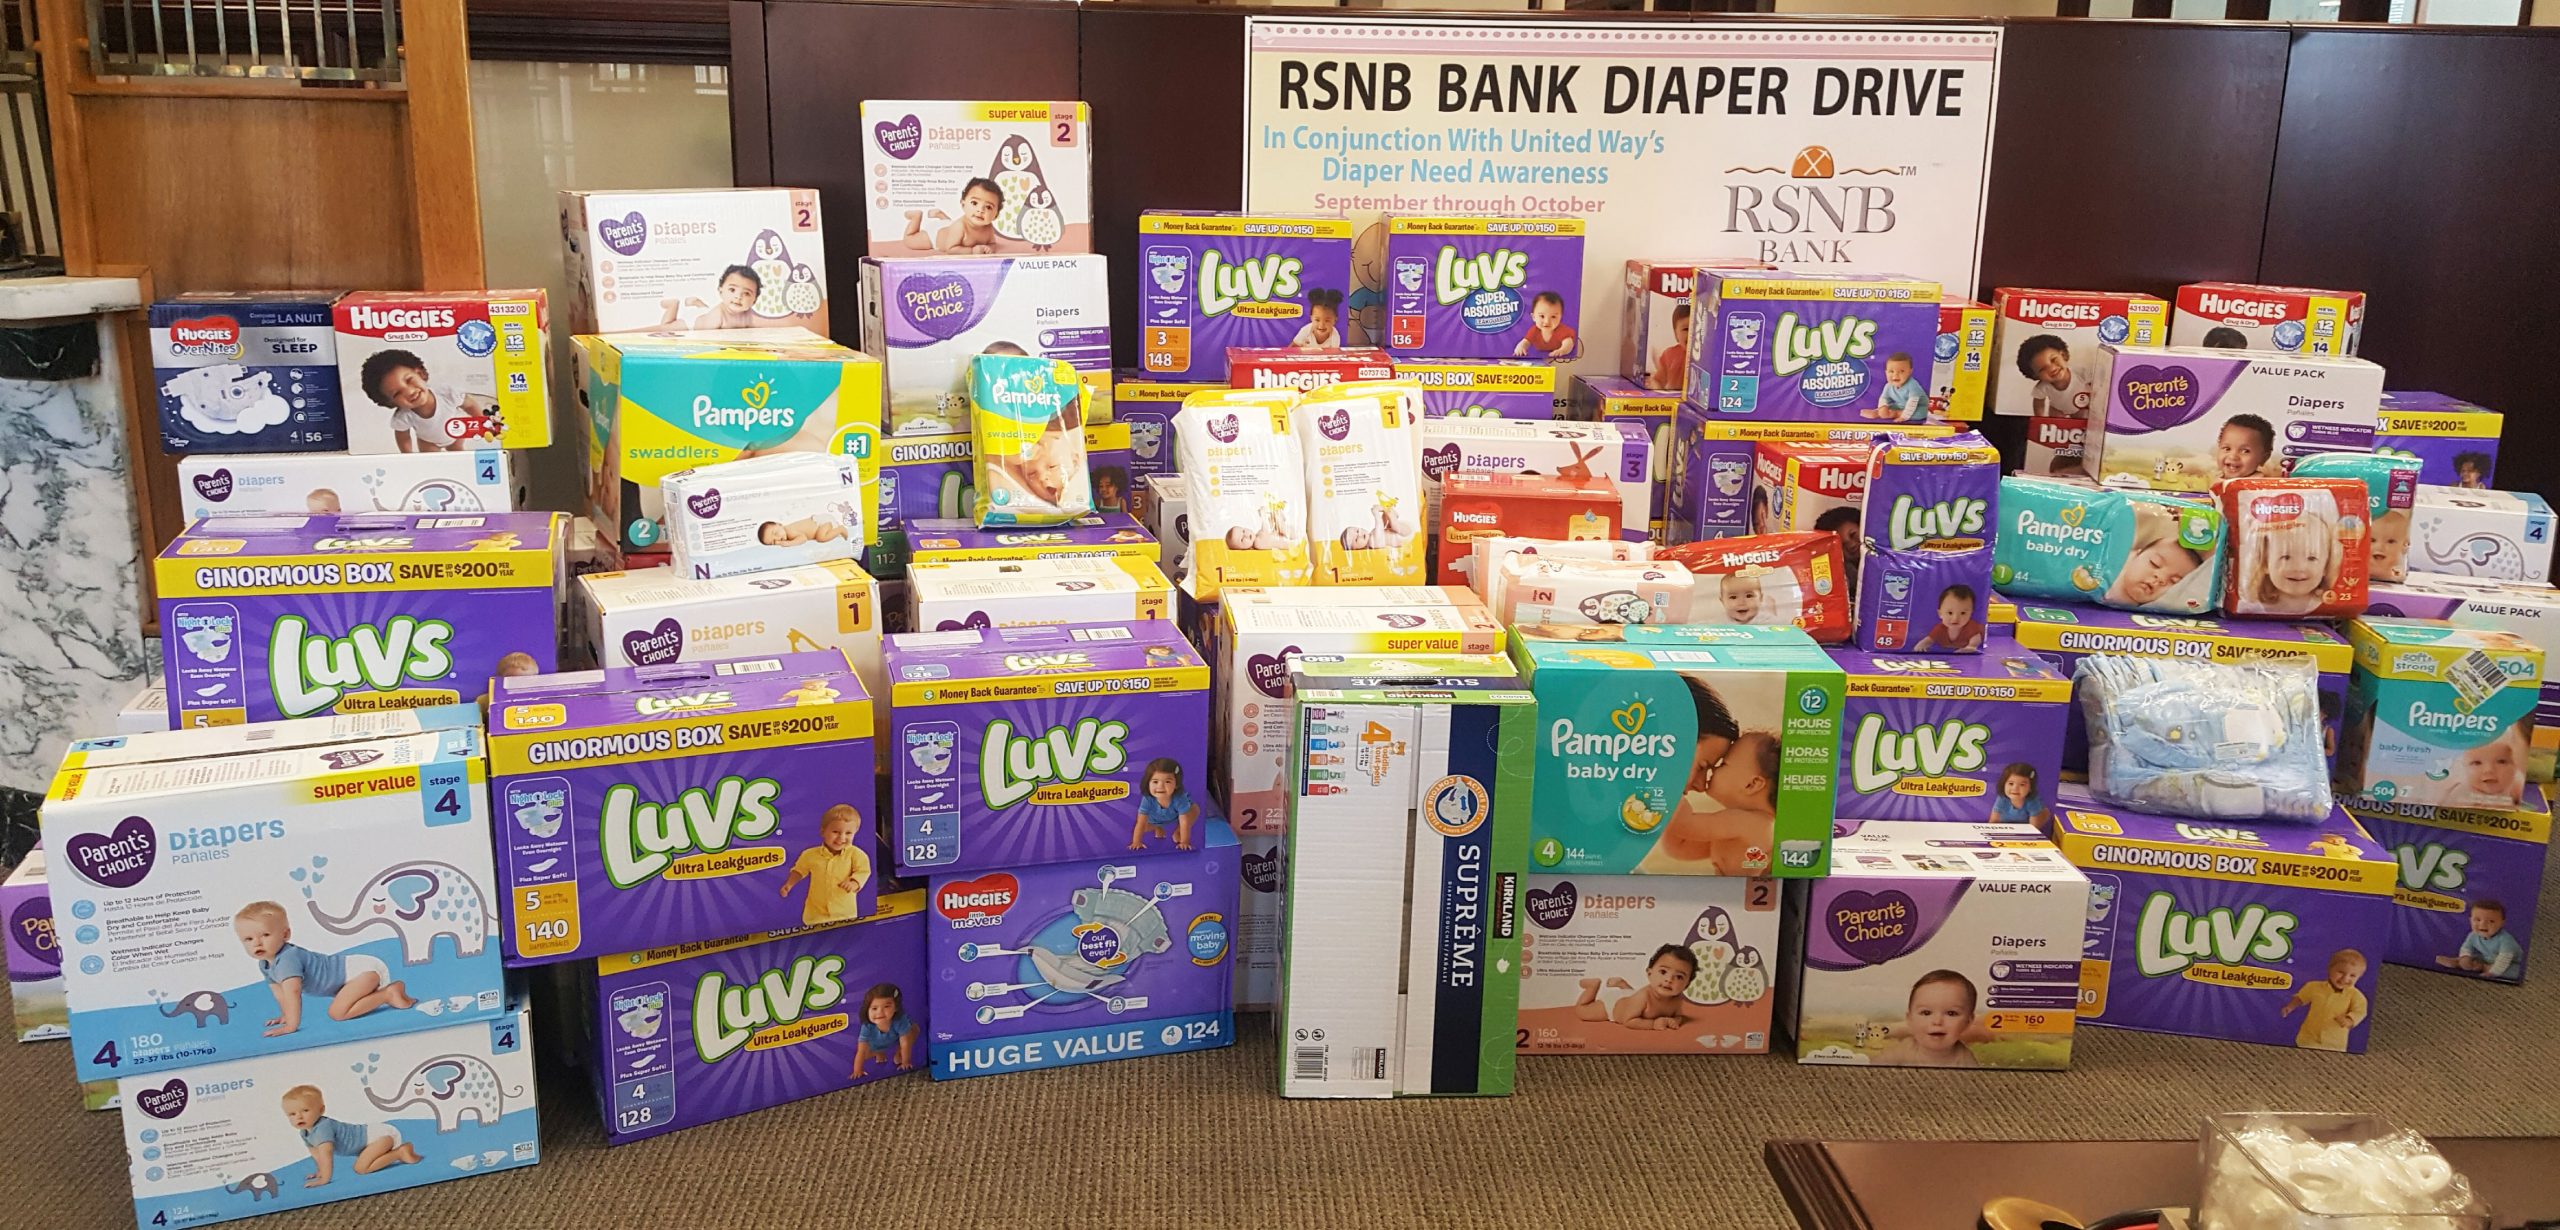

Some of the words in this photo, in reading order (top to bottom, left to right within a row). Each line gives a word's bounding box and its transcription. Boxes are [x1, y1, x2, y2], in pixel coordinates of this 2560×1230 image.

[1280, 61, 1411, 112] RSNB
[1438, 63, 1580, 113] BANK
[1604, 66, 1789, 115] DIAPER
[1812, 67, 1964, 116] DRIVE
[989, 110, 1017, 120] super
[1020, 110, 1047, 119] value
[928, 128, 990, 140] Diapers
[890, 139, 917, 151] CHOICE
[1264, 126, 1286, 148] In
[1293, 127, 1441, 156] Conjunction
[1448, 128, 1502, 152] With
[1511, 129, 1591, 152] United
[1598, 130, 1664, 159] Way's
[1323, 158, 1404, 187] Diaper
[1411, 160, 1472, 182] Need
[1479, 160, 1609, 184] Awareness
[1899, 166, 1916, 176] TM
[1315, 193, 1428, 215] September
[1433, 195, 1514, 214] through
[1522, 195, 1605, 212] October
[1721, 185, 1896, 233] RSNB
[615, 237, 641, 249] CHOICE
[1759, 240, 1852, 262] BANK
[1019, 261, 1049, 269] VALUE
[1052, 260, 1077, 269] PACK
[1475, 291, 1506, 304] SUPER
[1745, 286, 1766, 297] Money
[1768, 287, 1783, 296] Back
[1784, 287, 1820, 297] Guarantee
[1036, 307, 1079, 318] Diapers
[1257, 307, 1298, 315] Leakguards
[1464, 302, 1520, 317] ABSORBENT
[2199, 293, 2286, 319] HUGGIES
[278, 314, 293, 323] LA
[295, 314, 323, 323] NUIT
[351, 307, 454, 331] HUGGIES
[1393, 335, 1412, 345] 136
[272, 344, 317, 353] SLEEP
[1149, 354, 1172, 366] 148
[1816, 362, 1849, 375] SUPER
[2252, 366, 2290, 378] VALUE
[2294, 368, 2325, 379] PACK
[510, 374, 526, 383] 14
[1802, 374, 1865, 390] ABSORBENT
[2128, 379, 2188, 396] Parent's
[1722, 397, 1742, 408] 124
[2288, 395, 2344, 411] Diapers
[467, 420, 479, 428] 72
[2392, 419, 2422, 431] SAVE
[2428, 420, 2456, 431] $200
[290, 431, 297, 441] 4
[305, 432, 322, 442] 56
[630, 446, 718, 459] swaddlers
[1453, 512, 1497, 525] HUGGIES
[876, 553, 896, 564] 112
[843, 590, 865, 599] stage
[1142, 597, 1163, 606] stage
[2469, 603, 2506, 615] VALUE
[2510, 607, 2541, 618] PACK
[1388, 637, 1424, 651] super
[1426, 637, 1459, 650] value
[1467, 642, 1490, 651] stage
[1877, 636, 1893, 646] 48
[2060, 632, 2170, 654] GINORMOUS
[2174, 640, 2212, 659] BOX
[2216, 645, 2253, 657] SAVE
[2395, 662, 2435, 673] strong
[1054, 680, 1086, 694] SAVE
[1088, 680, 1103, 692] UP
[1106, 679, 1120, 691] TO
[1123, 677, 1150, 690] $150
[1851, 683, 1869, 693] Back
[1871, 684, 1911, 694] Guarantee
[1927, 685, 1956, 696] SAVE
[1958, 686, 1971, 696] UP
[1973, 687, 1987, 697] TO
[1989, 686, 2016, 698] $150
[939, 687, 968, 700] Money
[970, 687, 991, 698] Back
[994, 685, 1037, 697] Guarantee
[1788, 718, 1831, 729] HOURS
[529, 732, 670, 764] GINORMOUS
[676, 724, 724, 748] BOX
[729, 721, 771, 740] SAVE
[782, 716, 823, 734] $200
[1785, 747, 1829, 758] HORAS
[2379, 743, 2404, 753] baby
[2406, 743, 2431, 753] fresh
[1567, 763, 1620, 782] baby
[1626, 763, 1658, 782] dry
[429, 775, 460, 787] stage
[1783, 774, 1826, 785] HEURES
[1037, 789, 1063, 801] Ultra
[1065, 785, 1124, 801] Leakguards
[1900, 782, 1924, 791] Ultra
[1926, 783, 1981, 795] Leakguards
[2374, 786, 2395, 796] 504
[80, 830, 149, 865] Parent's
[907, 843, 938, 861] 128
[1542, 842, 1555, 859] 4
[1566, 848, 1585, 859] 144
[1782, 852, 1809, 866] 144
[165, 890, 200, 898] Protection
[1979, 883, 2016, 893] VALUE
[2019, 883, 2051, 893] PACK
[1501, 876, 1515, 936] KIRKLAND
[1531, 890, 1574, 911] Parent's
[1584, 894, 1656, 910] Diapers
[106, 916, 144, 925] Breathable
[136, 917, 179, 926] Comfortable
[952, 914, 1002, 930] movers
[1451, 845, 1482, 987] SUPRÊME
[1190, 932, 1225, 942] moving
[1845, 922, 1904, 943] Choice
[1082, 941, 1103, 949] best
[1105, 940, 1116, 948] fit
[1197, 940, 1220, 949] baby
[1992, 935, 2046, 948] Diapers
[2191, 967, 2219, 979] Ultra
[2221, 970, 2286, 986] Leakguards
[1990, 1015, 2002, 1028] 2
[2025, 1016, 2045, 1024] 160
[1538, 1028, 1558, 1038] 160
[131, 1033, 162, 1048] 180
[134, 1056, 158, 1065] 22-37
[176, 1047, 216, 1059] (10-17kg)
[950, 1042, 1042, 1072] HUGE
[1053, 1030, 1145, 1059] VALUE
[619, 1108, 651, 1128] 128
